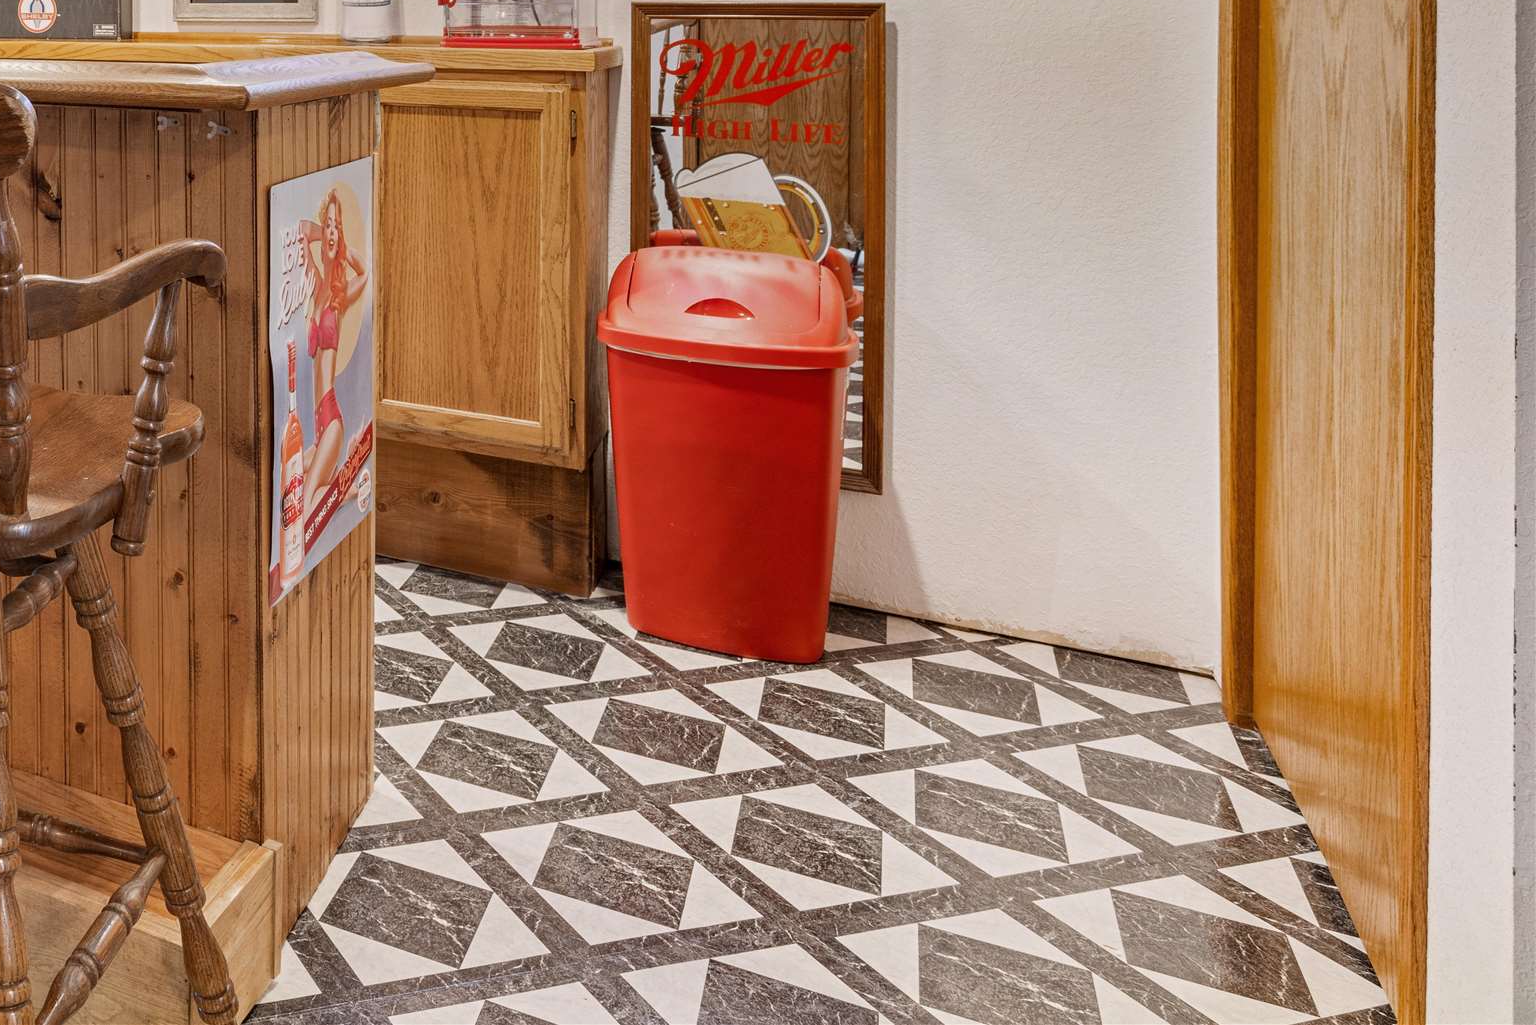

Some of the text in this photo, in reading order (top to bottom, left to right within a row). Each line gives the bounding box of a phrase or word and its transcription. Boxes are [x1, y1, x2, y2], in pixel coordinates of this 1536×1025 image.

[659, 38, 856, 107] Miller
[670, 112, 849, 145] HIGH LIFE
[282, 242, 305, 275] LOVE
